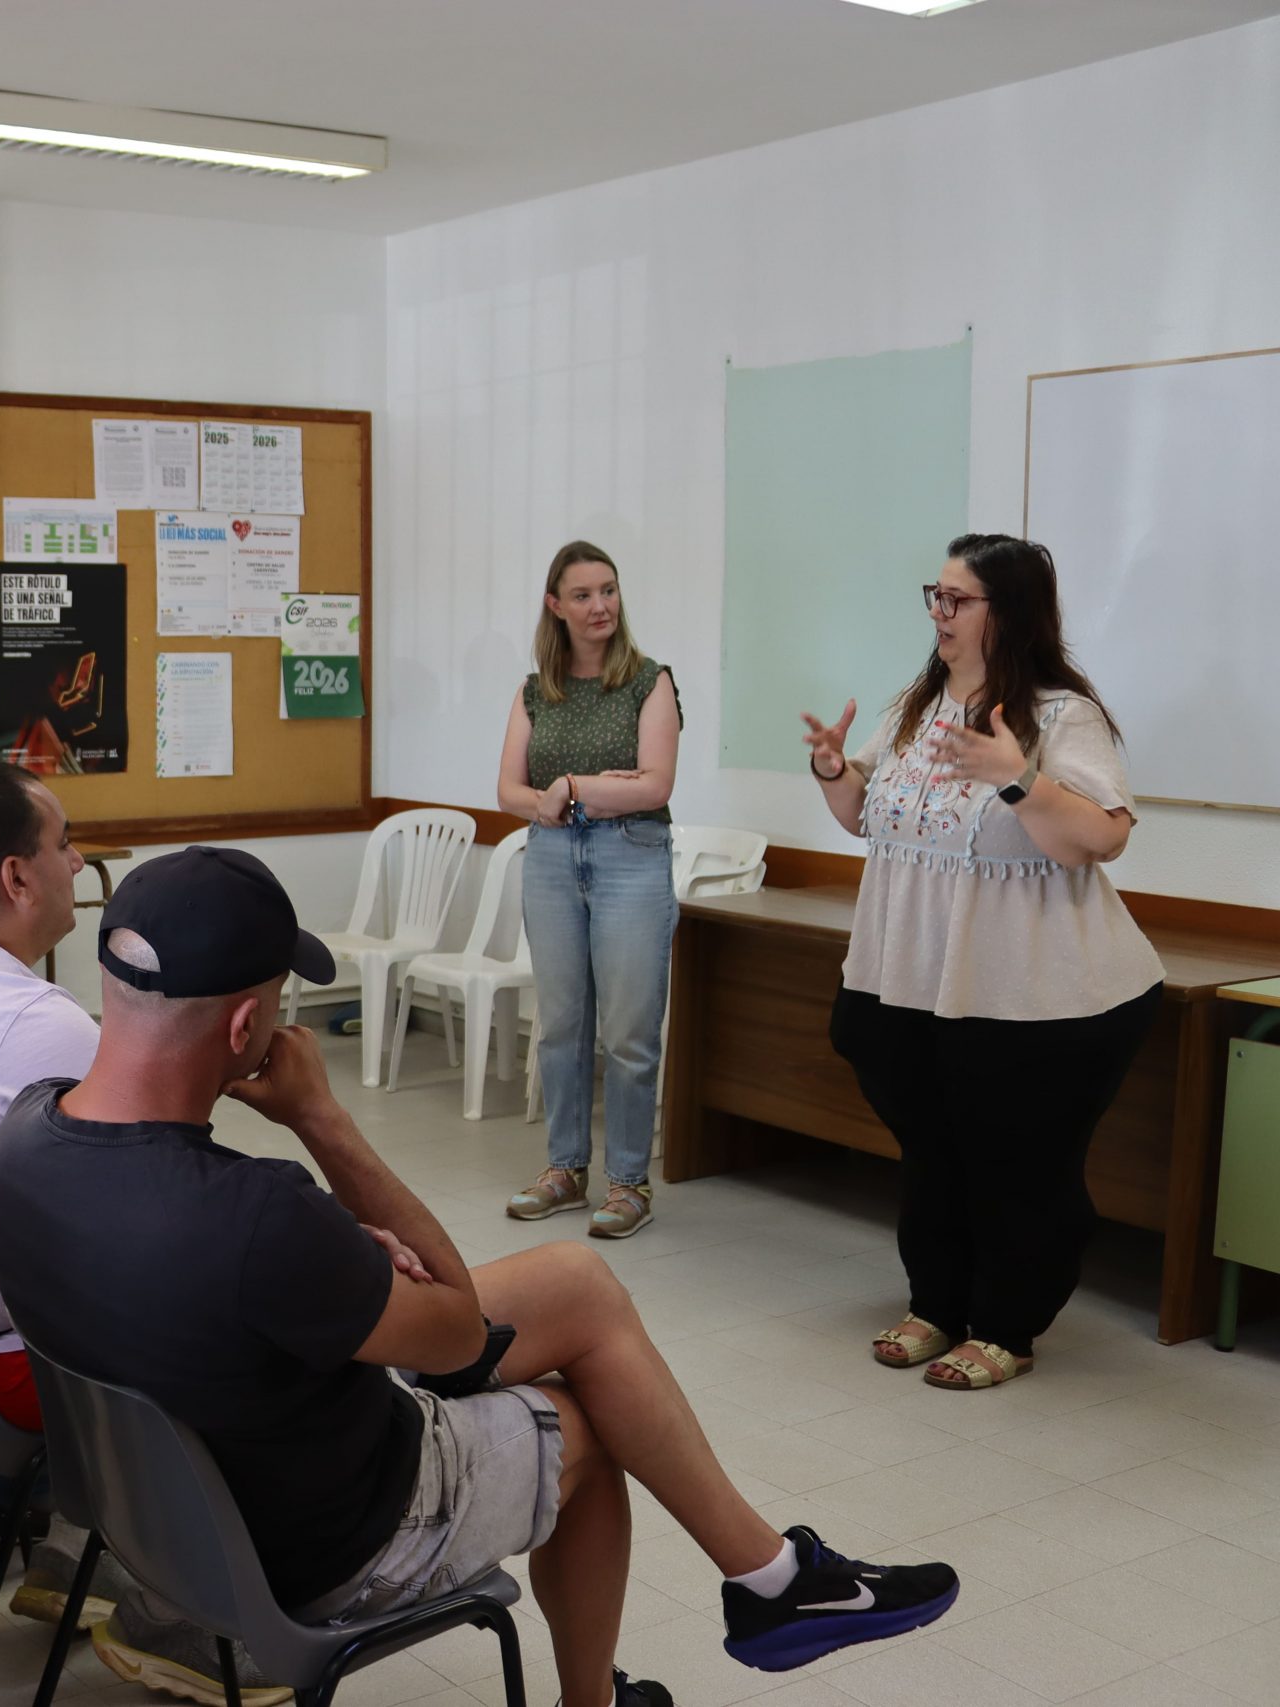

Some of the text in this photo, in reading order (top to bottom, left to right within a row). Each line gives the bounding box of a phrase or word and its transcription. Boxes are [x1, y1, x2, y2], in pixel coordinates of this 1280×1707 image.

[204, 431, 229, 445] 2025
[252, 435, 277, 448] 2026
[177, 525, 196, 540] MÁS
[197, 527, 227, 541] SOCIAL
[3, 573, 61, 589] ESTE RÓTULO
[3, 592, 14, 605] ES
[17, 592, 35, 605] UNA
[3, 607, 14, 621] DE
[290, 606, 309, 616] CSIF
[306, 617, 338, 628] 2026
[294, 660, 350, 695] 2026
[294, 687, 314, 696] FELIZ
